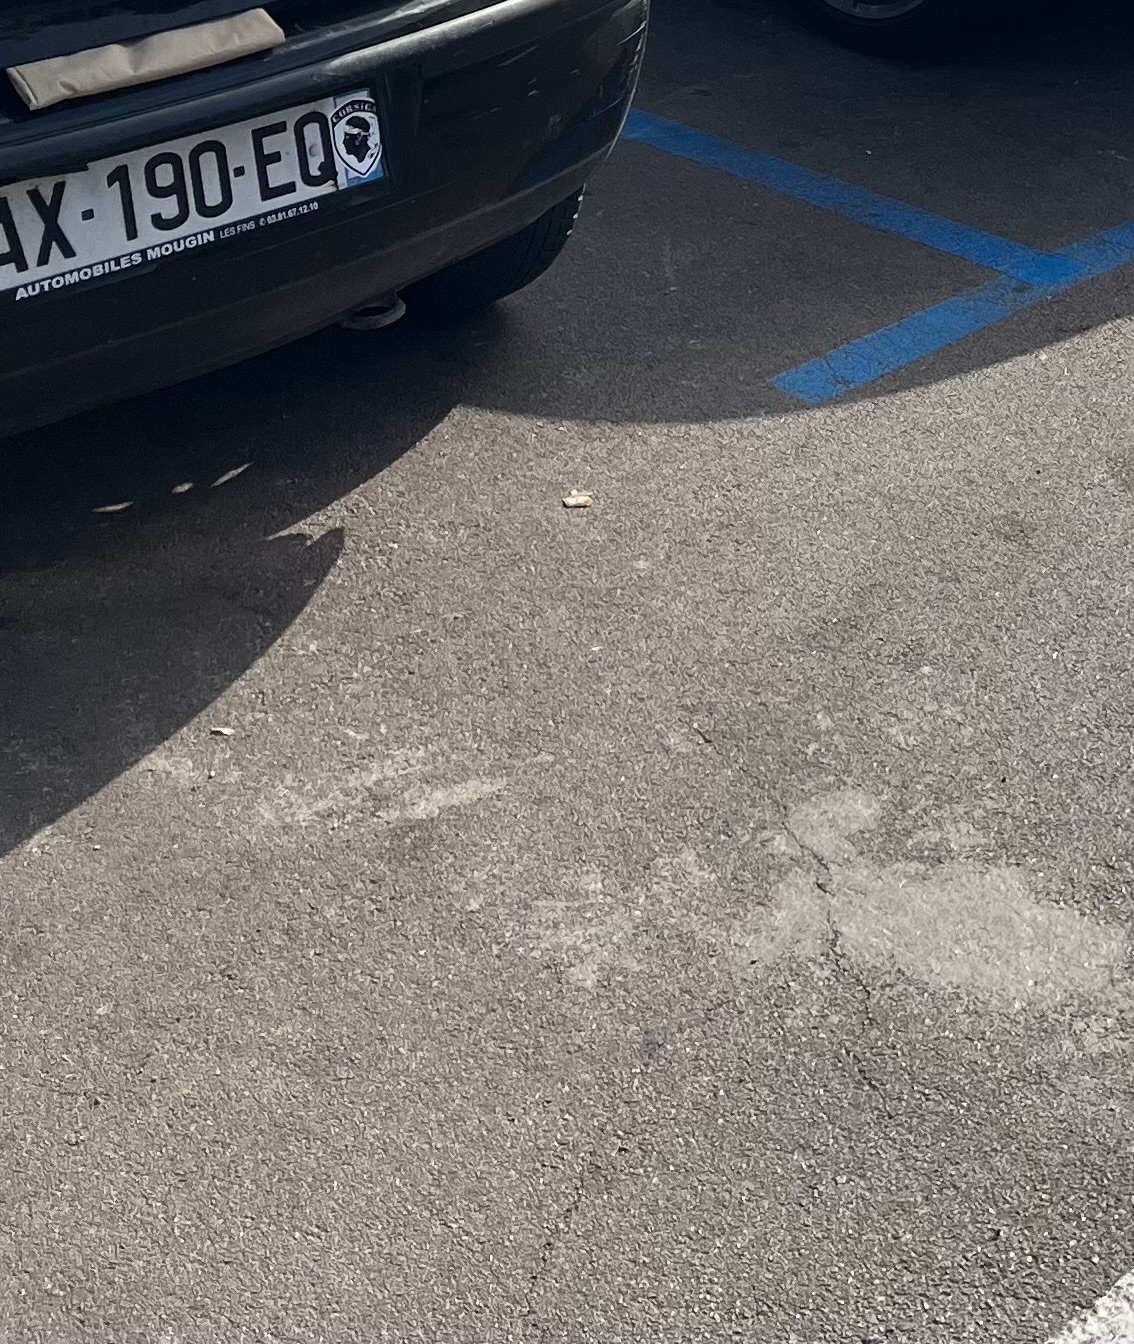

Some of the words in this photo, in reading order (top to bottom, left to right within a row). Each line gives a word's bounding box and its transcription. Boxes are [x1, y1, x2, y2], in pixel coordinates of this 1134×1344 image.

[15, 251, 142, 301] AUTOMOBILES
[146, 229, 215, 262] MOUGIN
[219, 226, 236, 240] LES
[236, 220, 256, 234] FINS
